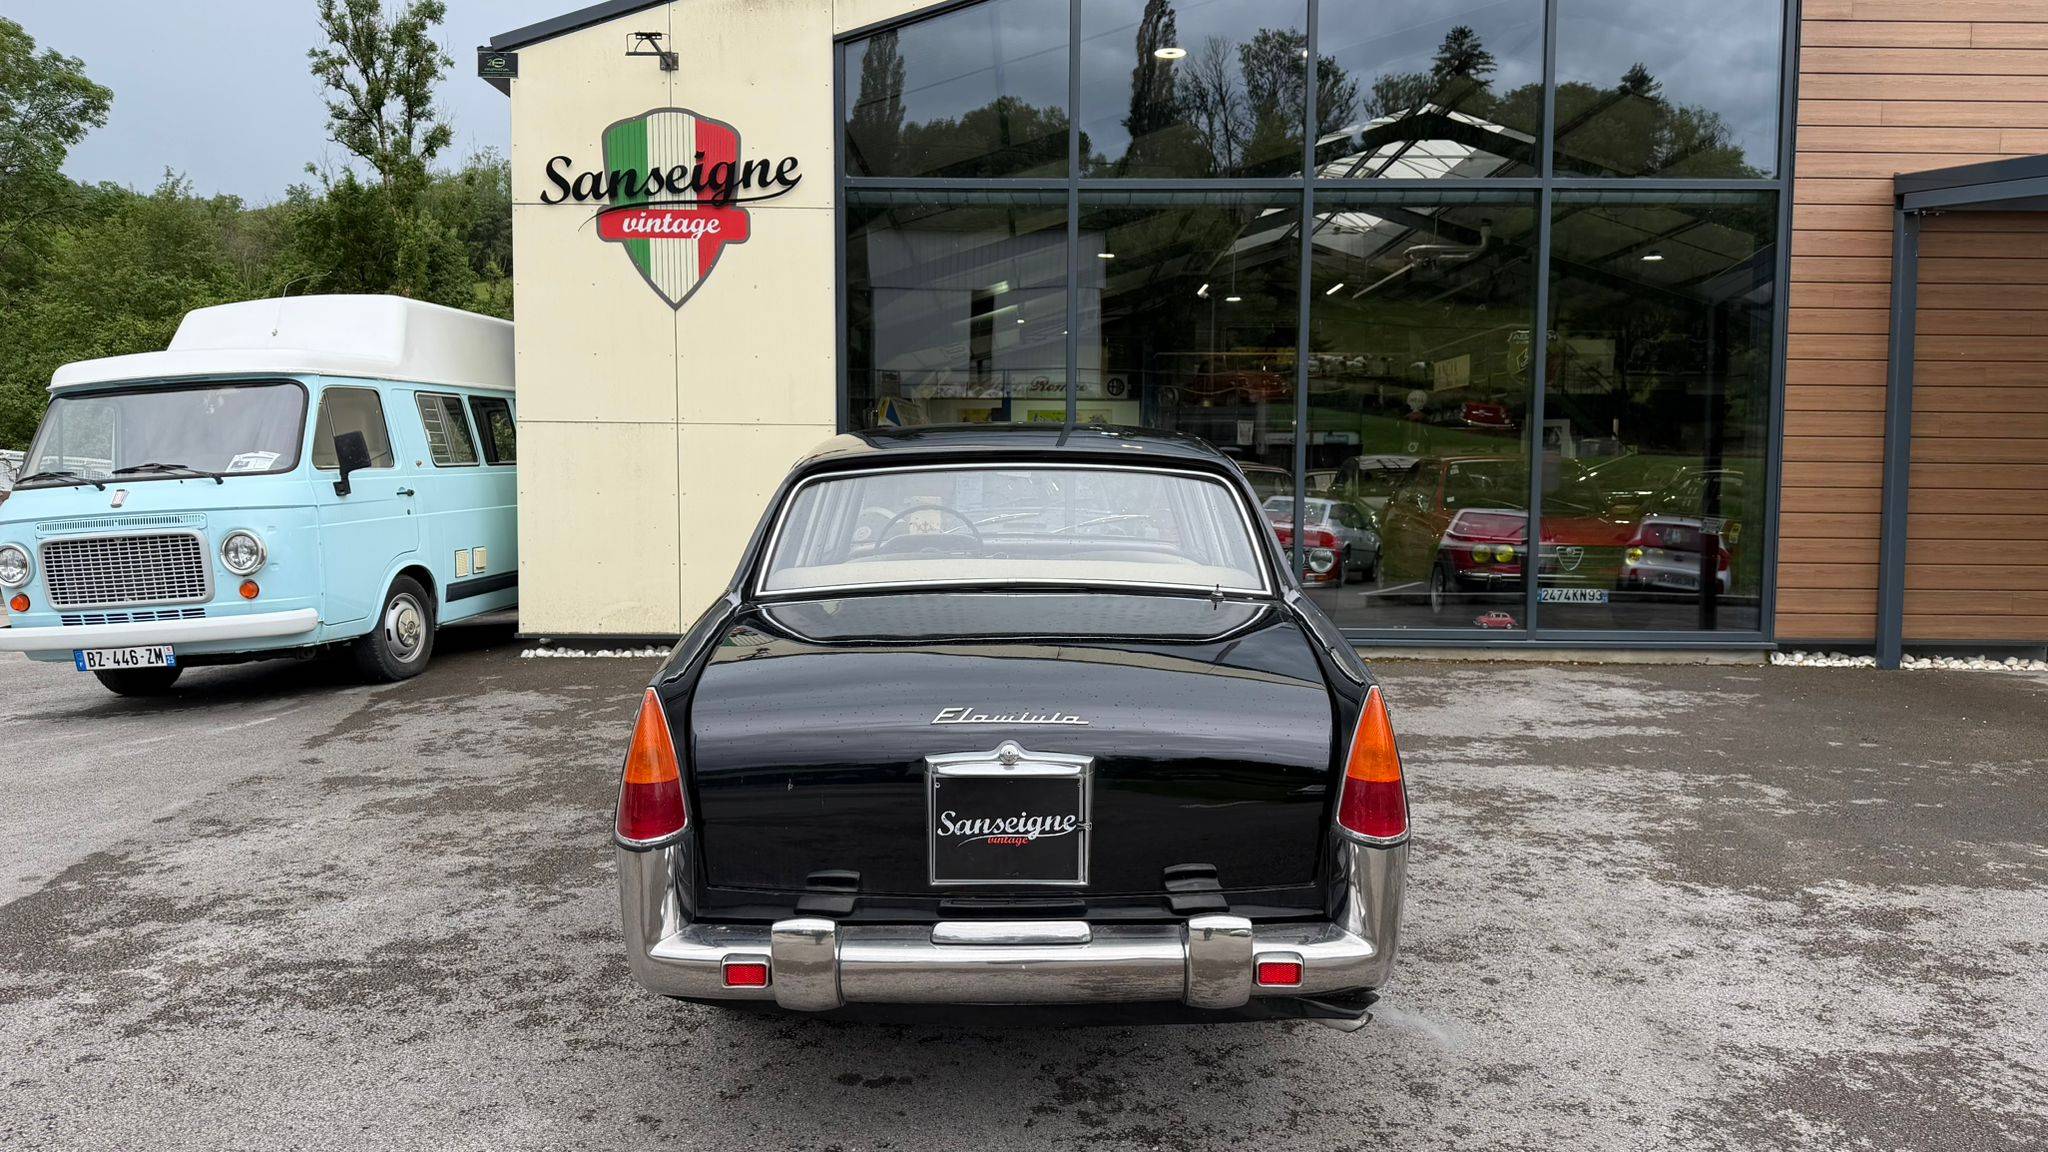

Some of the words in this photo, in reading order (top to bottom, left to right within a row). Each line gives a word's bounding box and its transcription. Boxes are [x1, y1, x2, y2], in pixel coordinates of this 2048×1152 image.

[540, 151, 802, 207] Sanseigne
[622, 211, 721, 240] vintage
[1542, 589, 1603, 601] 2474KN93
[86, 647, 165, 668] BZ-446-ZM
[937, 811, 1078, 840] Sanseigne
[988, 835, 1029, 847] vintage
